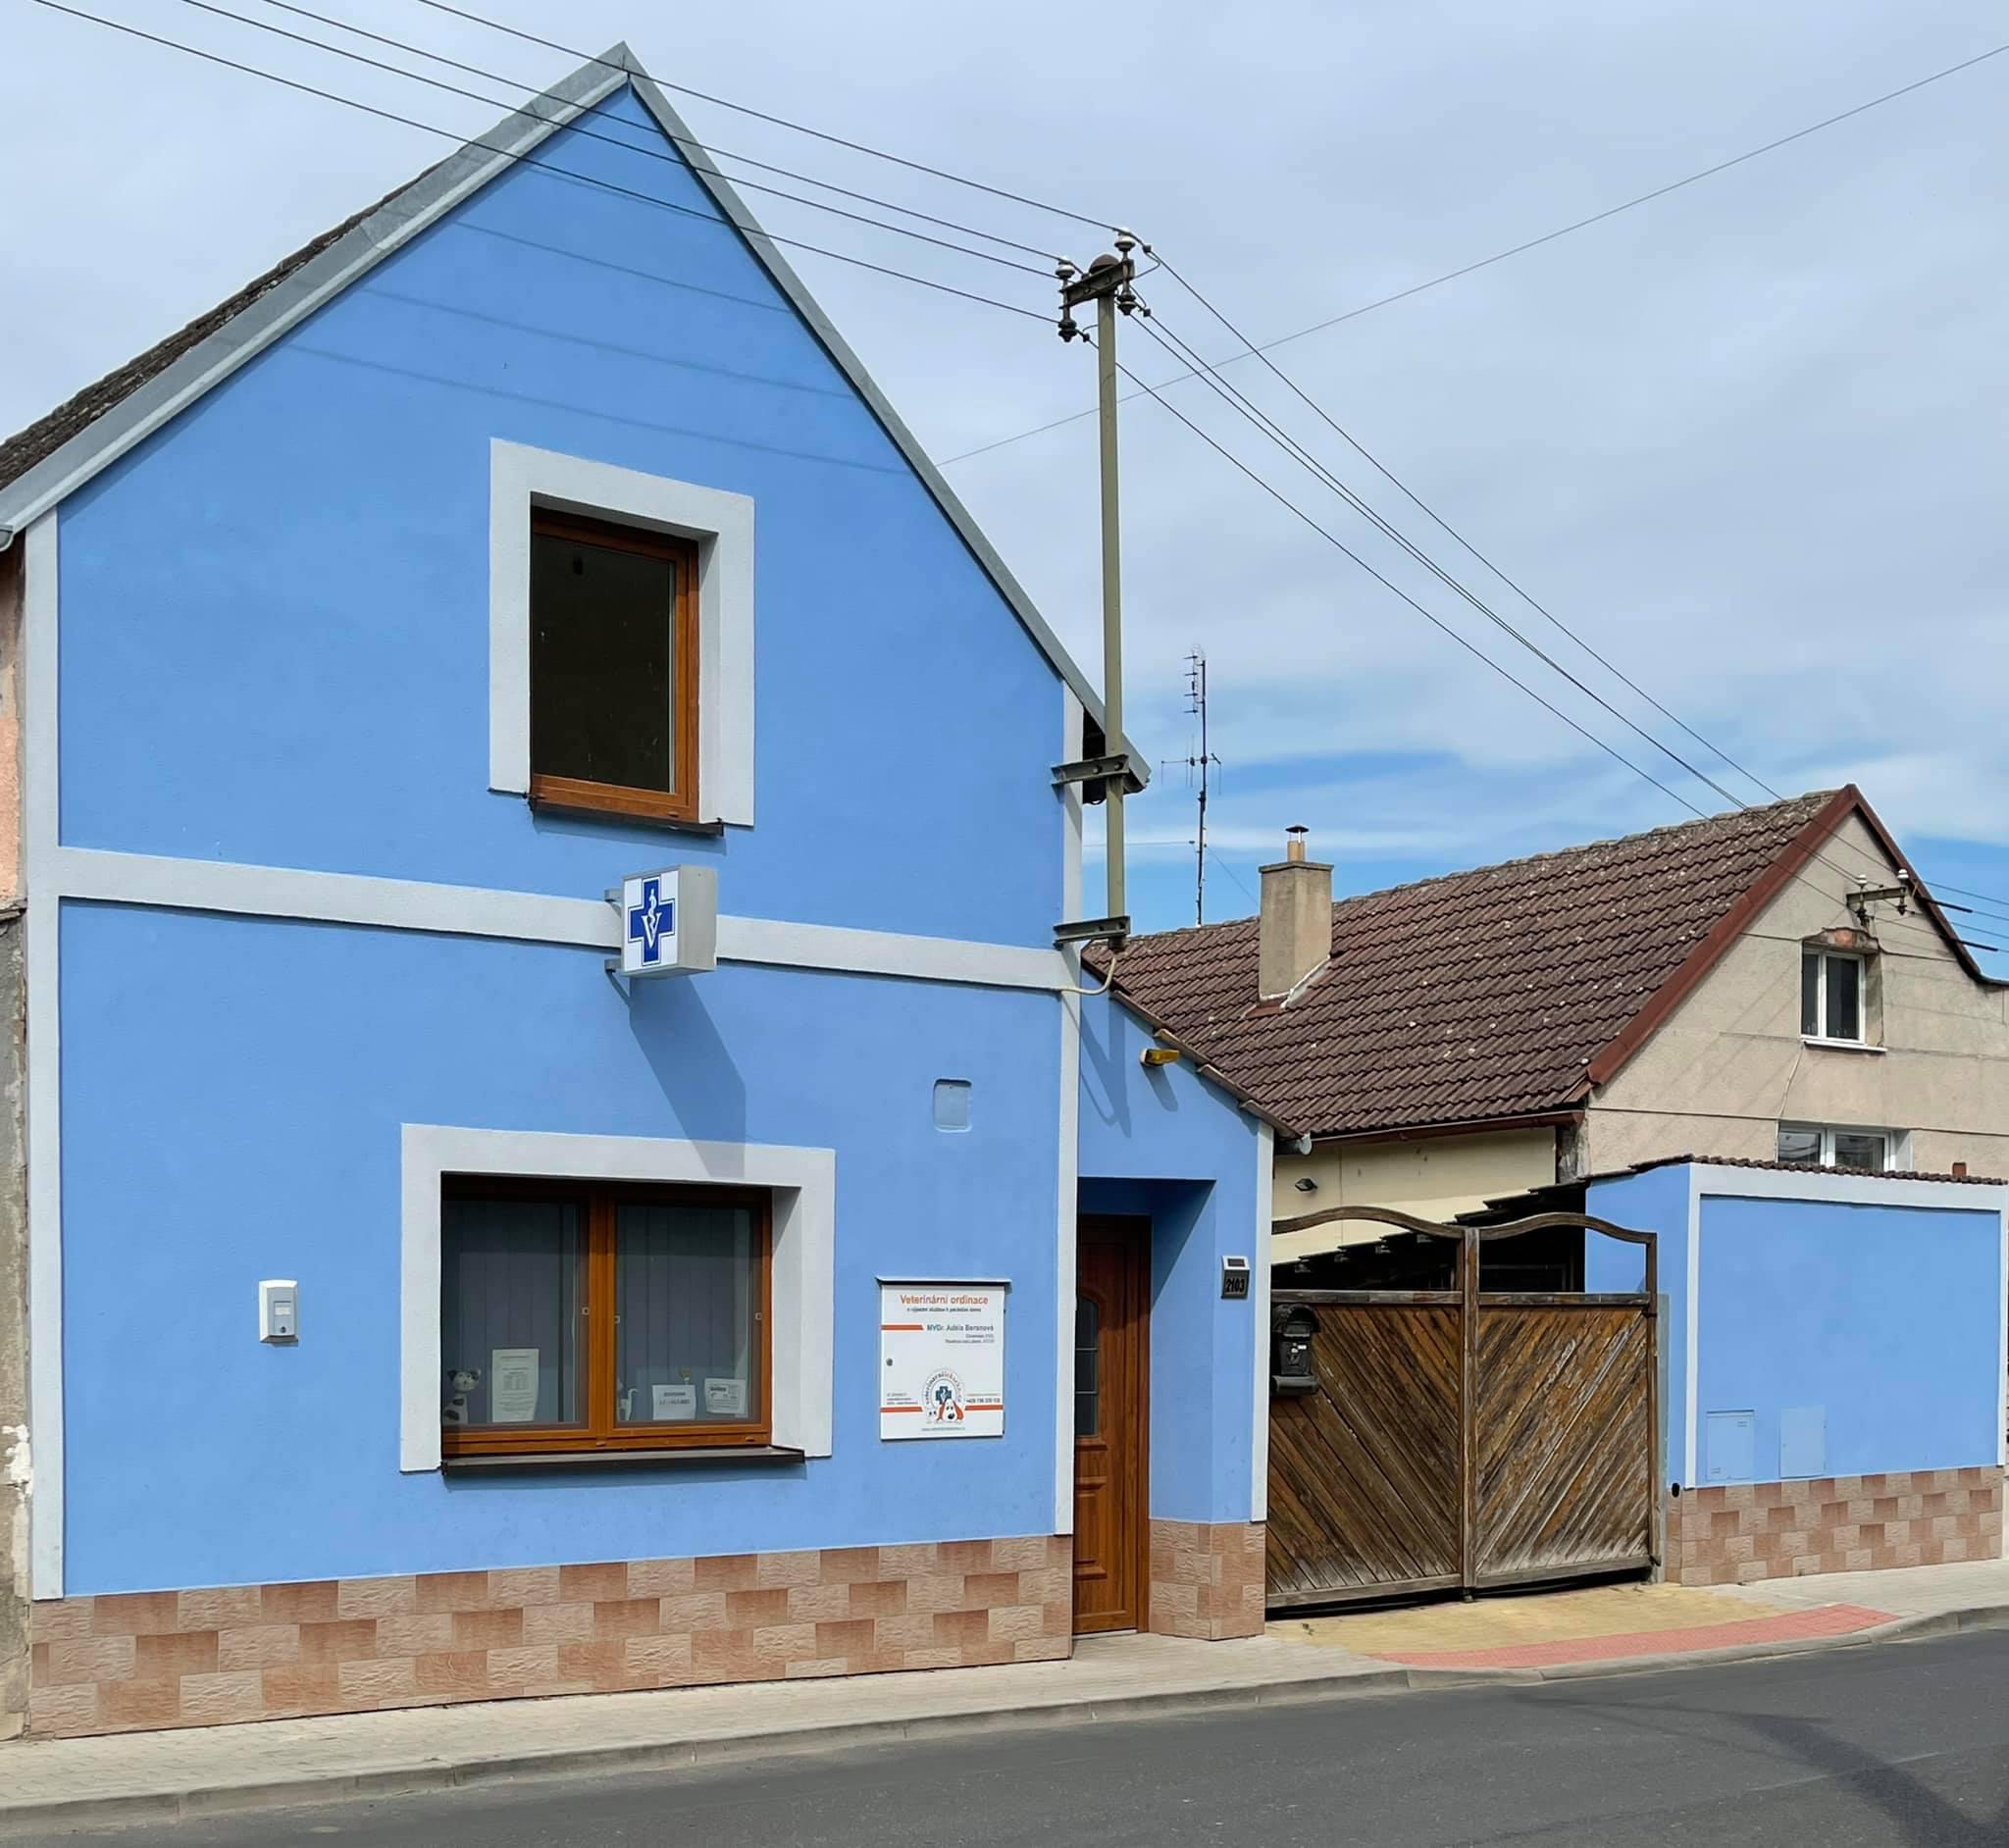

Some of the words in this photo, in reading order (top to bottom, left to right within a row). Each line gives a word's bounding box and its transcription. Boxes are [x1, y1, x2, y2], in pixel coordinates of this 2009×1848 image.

[1225, 1278, 1245, 1293] 2103
[900, 1295, 949, 1305] Veterinární
[951, 1295, 989, 1305] ordinace
